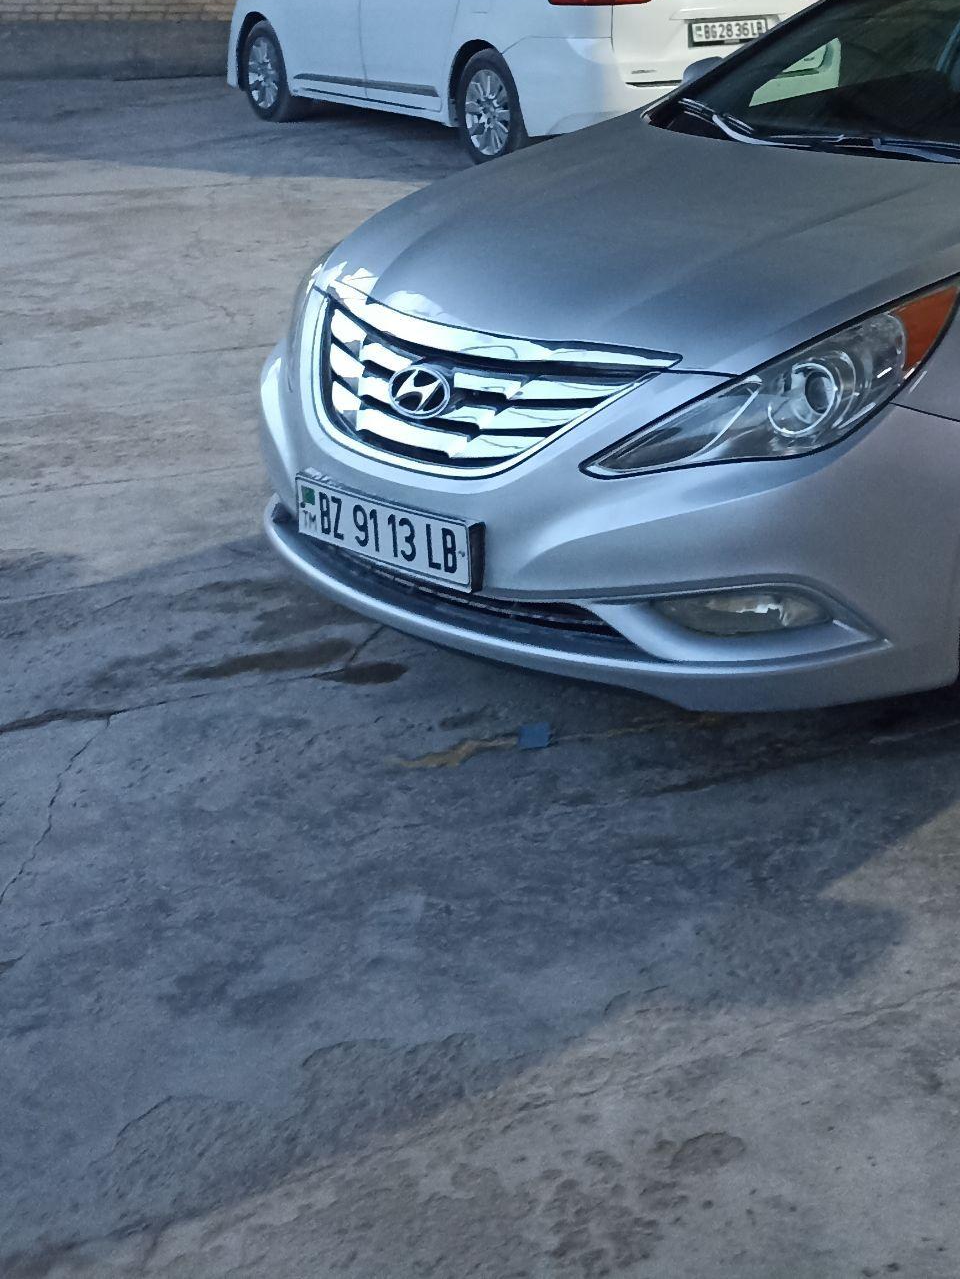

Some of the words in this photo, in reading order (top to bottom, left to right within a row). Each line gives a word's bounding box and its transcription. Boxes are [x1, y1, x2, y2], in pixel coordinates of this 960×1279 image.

[719, 24, 733, 38] 28
[735, 23, 749, 36] 36
[319, 492, 344, 540] BZ
[353, 504, 380, 552] 91
[388, 513, 417, 562] 13
[426, 524, 458, 573] LB
